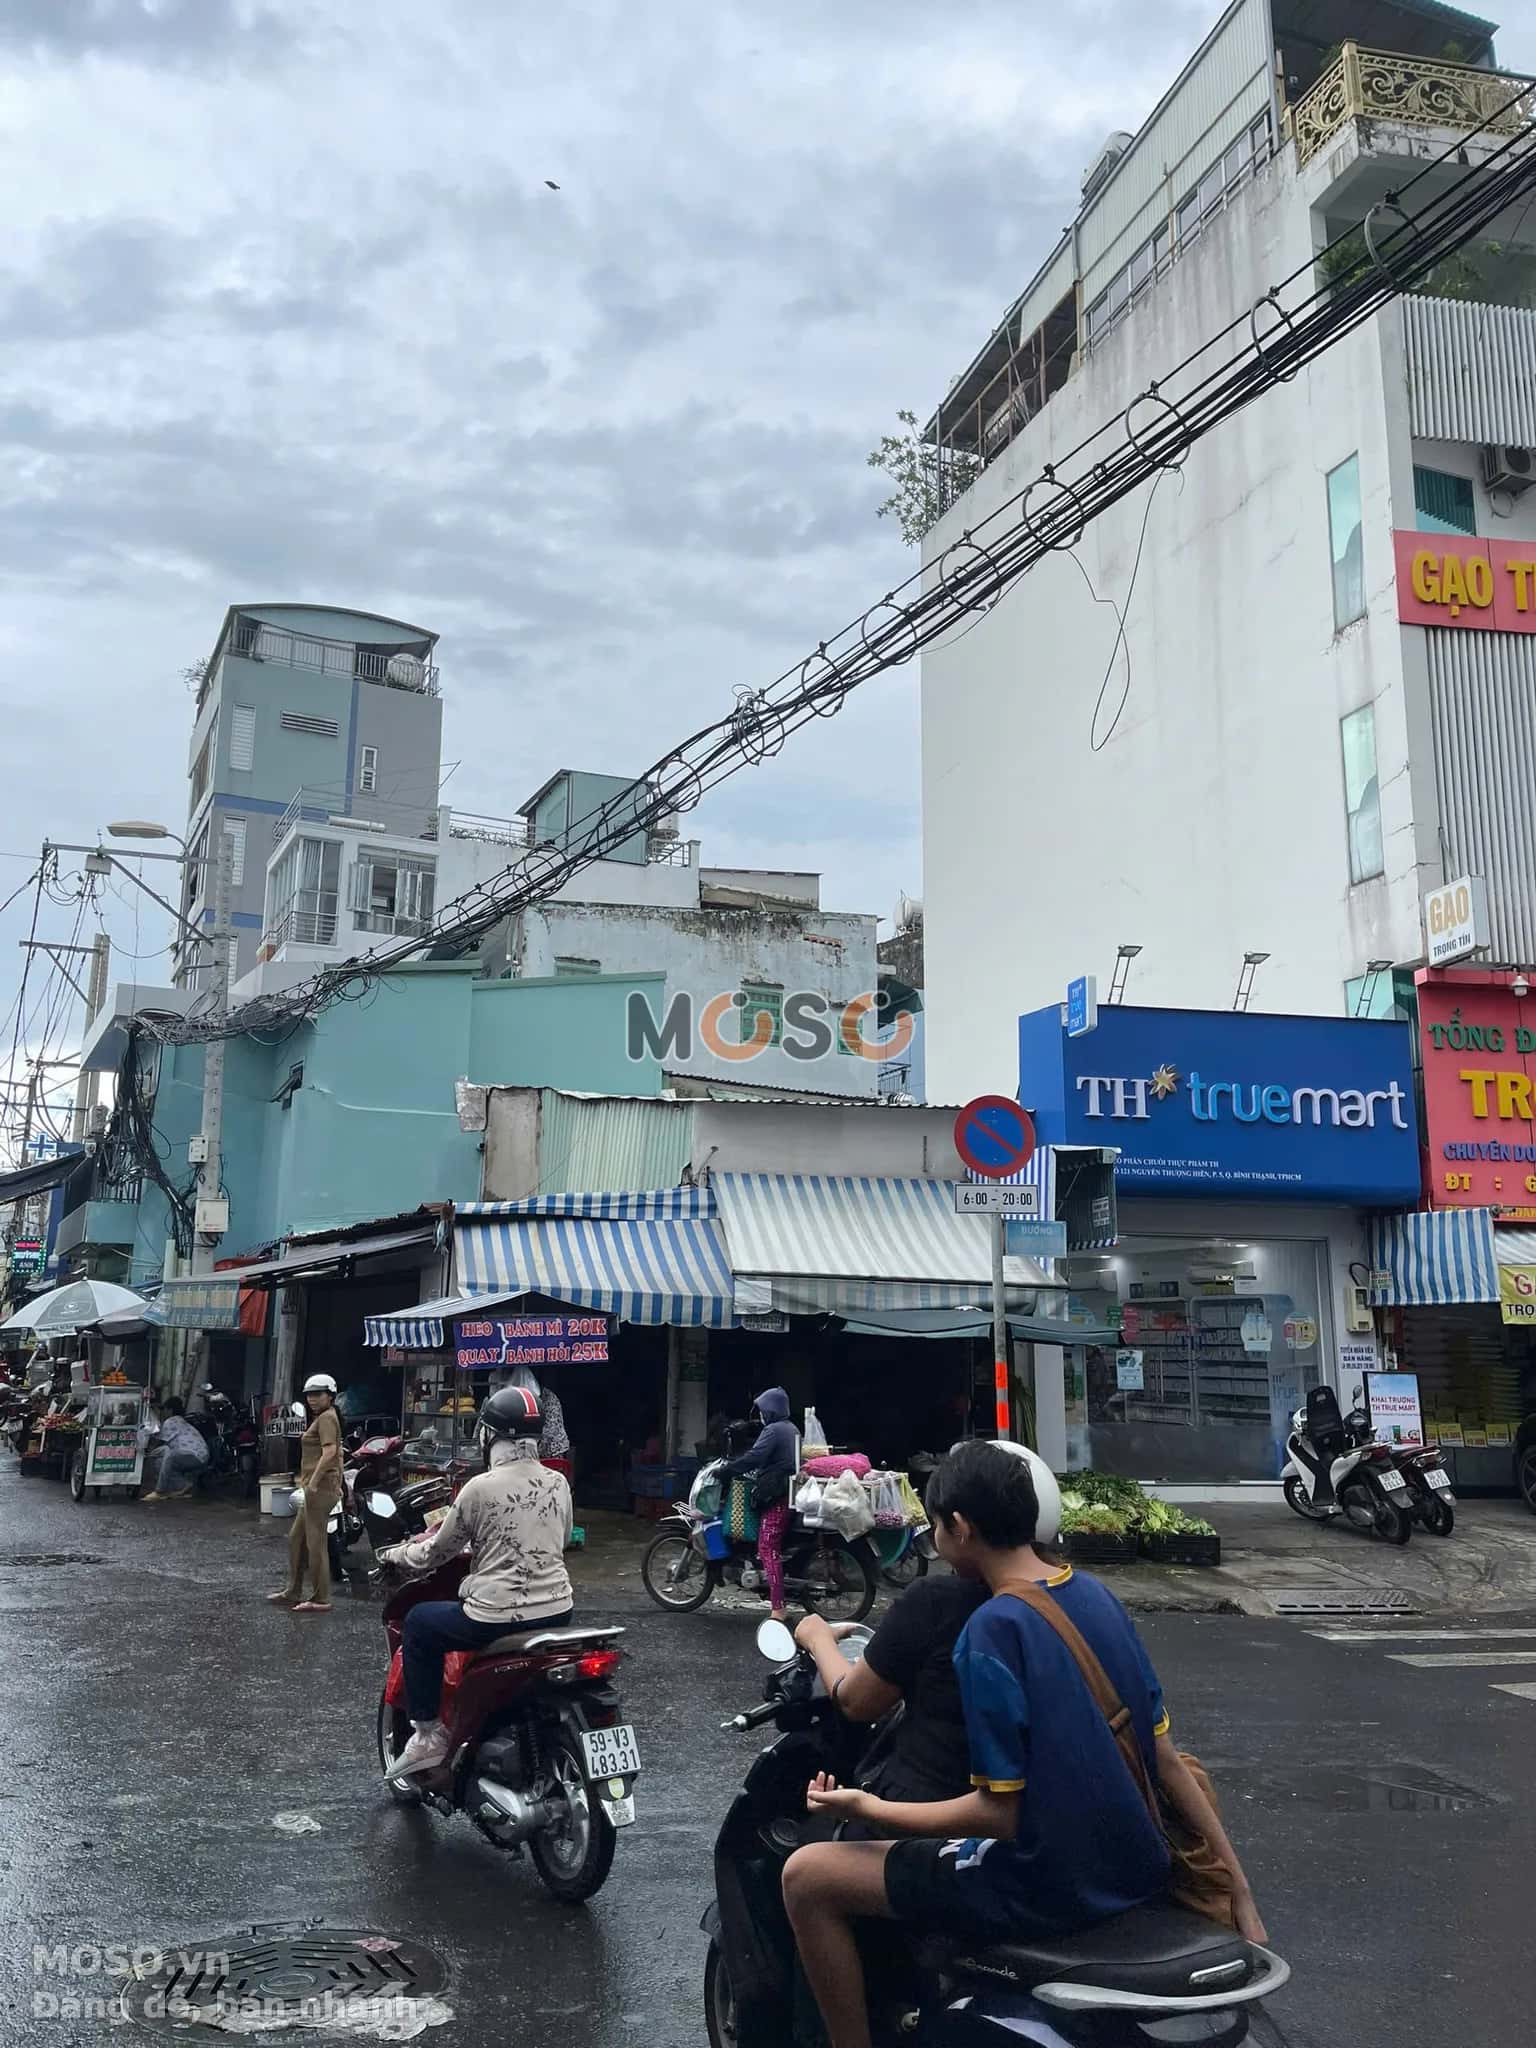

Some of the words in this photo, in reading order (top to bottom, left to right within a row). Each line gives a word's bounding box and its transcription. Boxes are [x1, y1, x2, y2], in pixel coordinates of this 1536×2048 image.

[1412, 550, 1494, 617] GẠO
[1504, 560, 1536, 612] T
[1430, 887, 1469, 937] GẠO
[1428, 1007, 1506, 1052] TỔNG
[1514, 1024, 1536, 1053] Đ
[1076, 1075, 1150, 1119] TH
[1459, 1070, 1536, 1120] TR
[1443, 1138, 1512, 1162] CHUYÊN
[1444, 1172, 1472, 1191] ĐT
[963, 1192, 988, 1206] 6:00
[1002, 1192, 1033, 1206] 20:00
[461, 1321, 494, 1338] HEO
[504, 1318, 544, 1338] BÁNH
[567, 1318, 608, 1337] 20K
[457, 1349, 499, 1368] QUAY
[505, 1346, 545, 1365] BÁNH
[571, 1342, 609, 1361] 25K
[590, 1727, 630, 1753] 59-V3
[592, 1748, 638, 1777] 483.31
